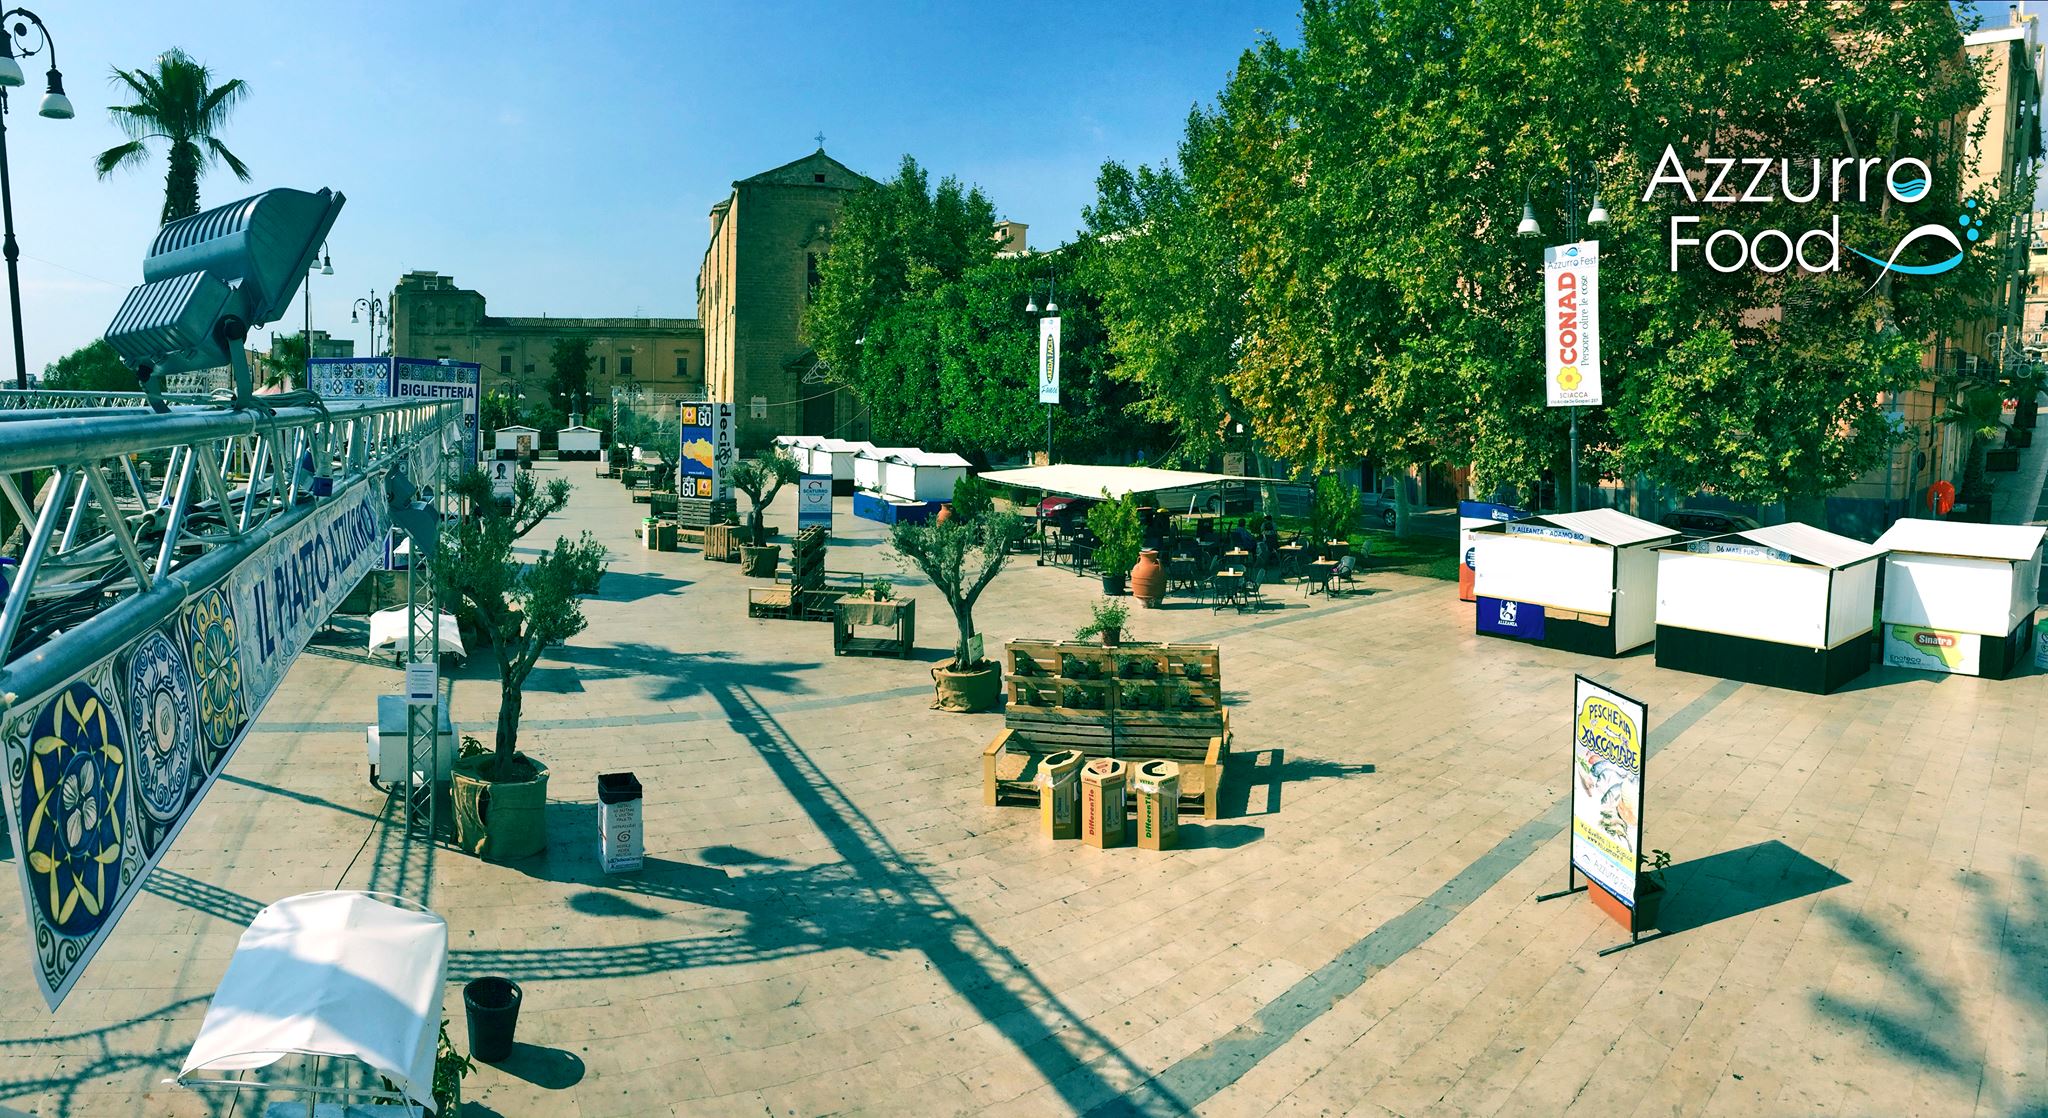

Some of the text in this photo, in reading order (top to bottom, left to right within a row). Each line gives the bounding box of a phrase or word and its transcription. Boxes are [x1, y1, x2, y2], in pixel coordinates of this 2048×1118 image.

[1548, 256, 1597, 270] Azzurro Fest
[1580, 275, 1588, 295] cose
[1558, 271, 1578, 365] CONAD
[1578, 309, 1589, 330] oltre
[1580, 332, 1590, 366] Persone
[401, 384, 474, 399] BIGLIETTERIA
[698, 411, 712, 427] GO
[682, 482, 696, 498] GO
[1517, 527, 1545, 535] ALLEANZA
[1573, 533, 1585, 541] BIO
[253, 499, 376, 664] IL PIATTO AZZURRO
[1498, 619, 1518, 627] ALLEANZA
[1918, 634, 1953, 647] Sinatra
[1889, 653, 1922, 663] Enoteca
[1589, 704, 1632, 740] PESCHERIA
[1582, 724, 1639, 770] XACCAMARE
